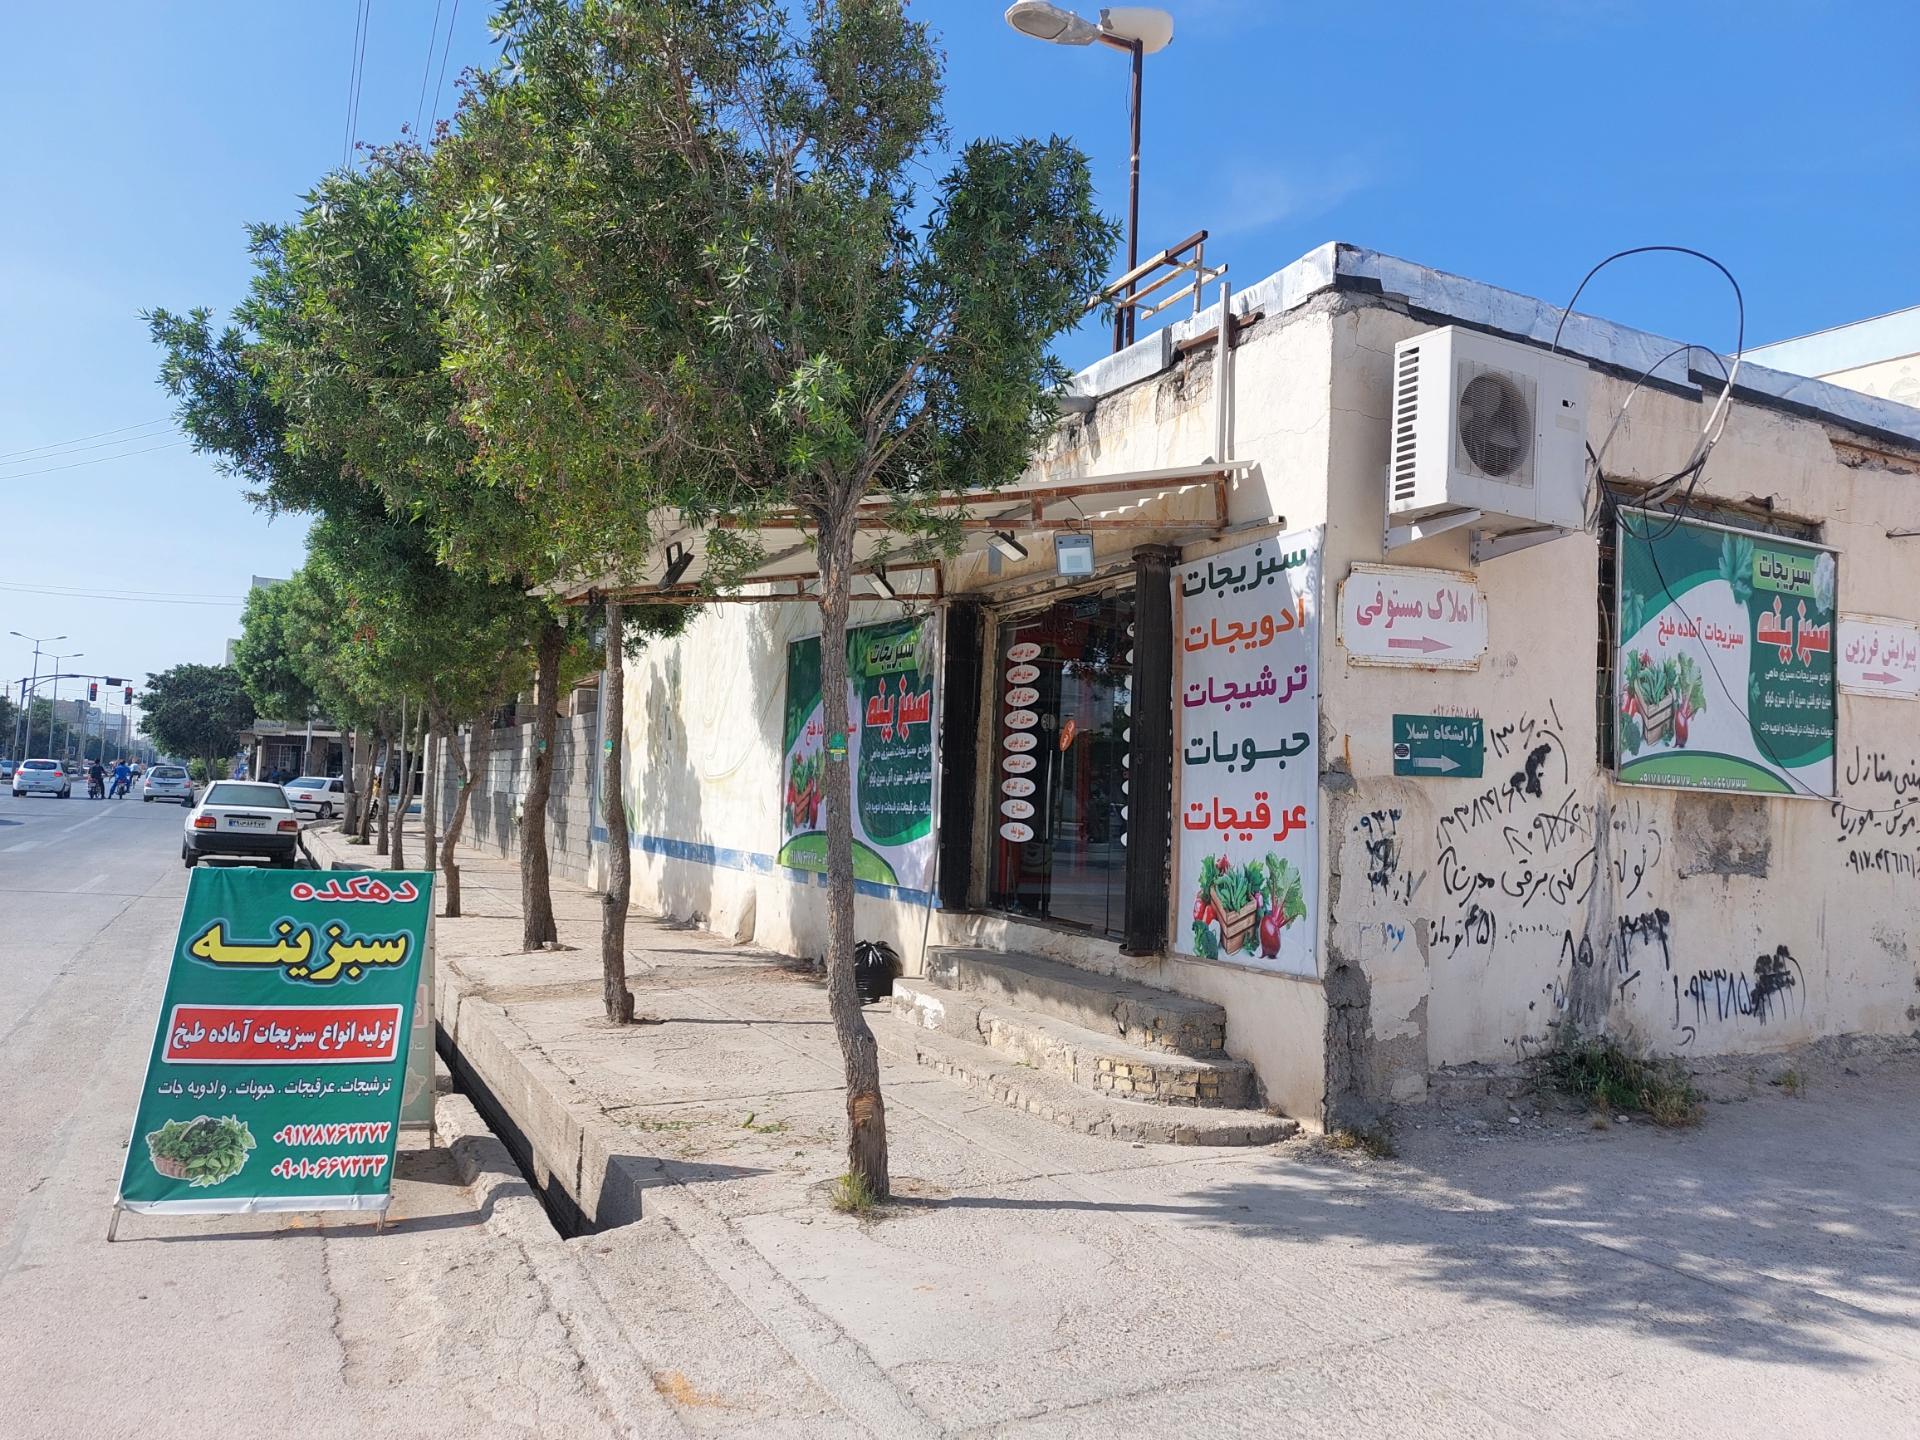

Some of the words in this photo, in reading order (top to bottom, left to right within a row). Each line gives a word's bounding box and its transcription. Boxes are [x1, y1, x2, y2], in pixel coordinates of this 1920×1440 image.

[1183, 543, 1307, 598] سبزیجات
[1760, 553, 1811, 591] سبزیجات
[1356, 580, 1423, 629] مستوفی
[1427, 588, 1475, 623] املاک
[1184, 595, 1305, 654] ادویجات
[1658, 615, 1675, 646] طبخ
[1677, 616, 1702, 638] آماده
[1705, 622, 1744, 649] سبزیجات
[1757, 594, 1831, 668] سبزینه
[870, 642, 914, 671] سبزیجات
[1845, 629, 1879, 665] فرزین
[1183, 664, 1308, 713] ترشیجات
[866, 674, 931, 743] سبزینه
[1405, 722, 1429, 745] شیلا
[1433, 721, 1480, 748] آرایشگاه
[1184, 730, 1311, 773] حبوبات
[1846, 745, 1893, 786] منازل
[1183, 791, 1307, 842] عرقیجات
[291, 876, 419, 902] دهکده
[188, 918, 410, 984] سبزینه
[172, 1021, 206, 1049] طبخ
[208, 1018, 254, 1044] آماده
[253, 1022, 316, 1050] سبزیجات
[318, 1021, 356, 1050] انواع
[358, 1020, 394, 1049] تولید
[158, 1080, 183, 1098] جات
[235, 1080, 276, 1099] حبوبات
[284, 1078, 335, 1098] عرقیجات
